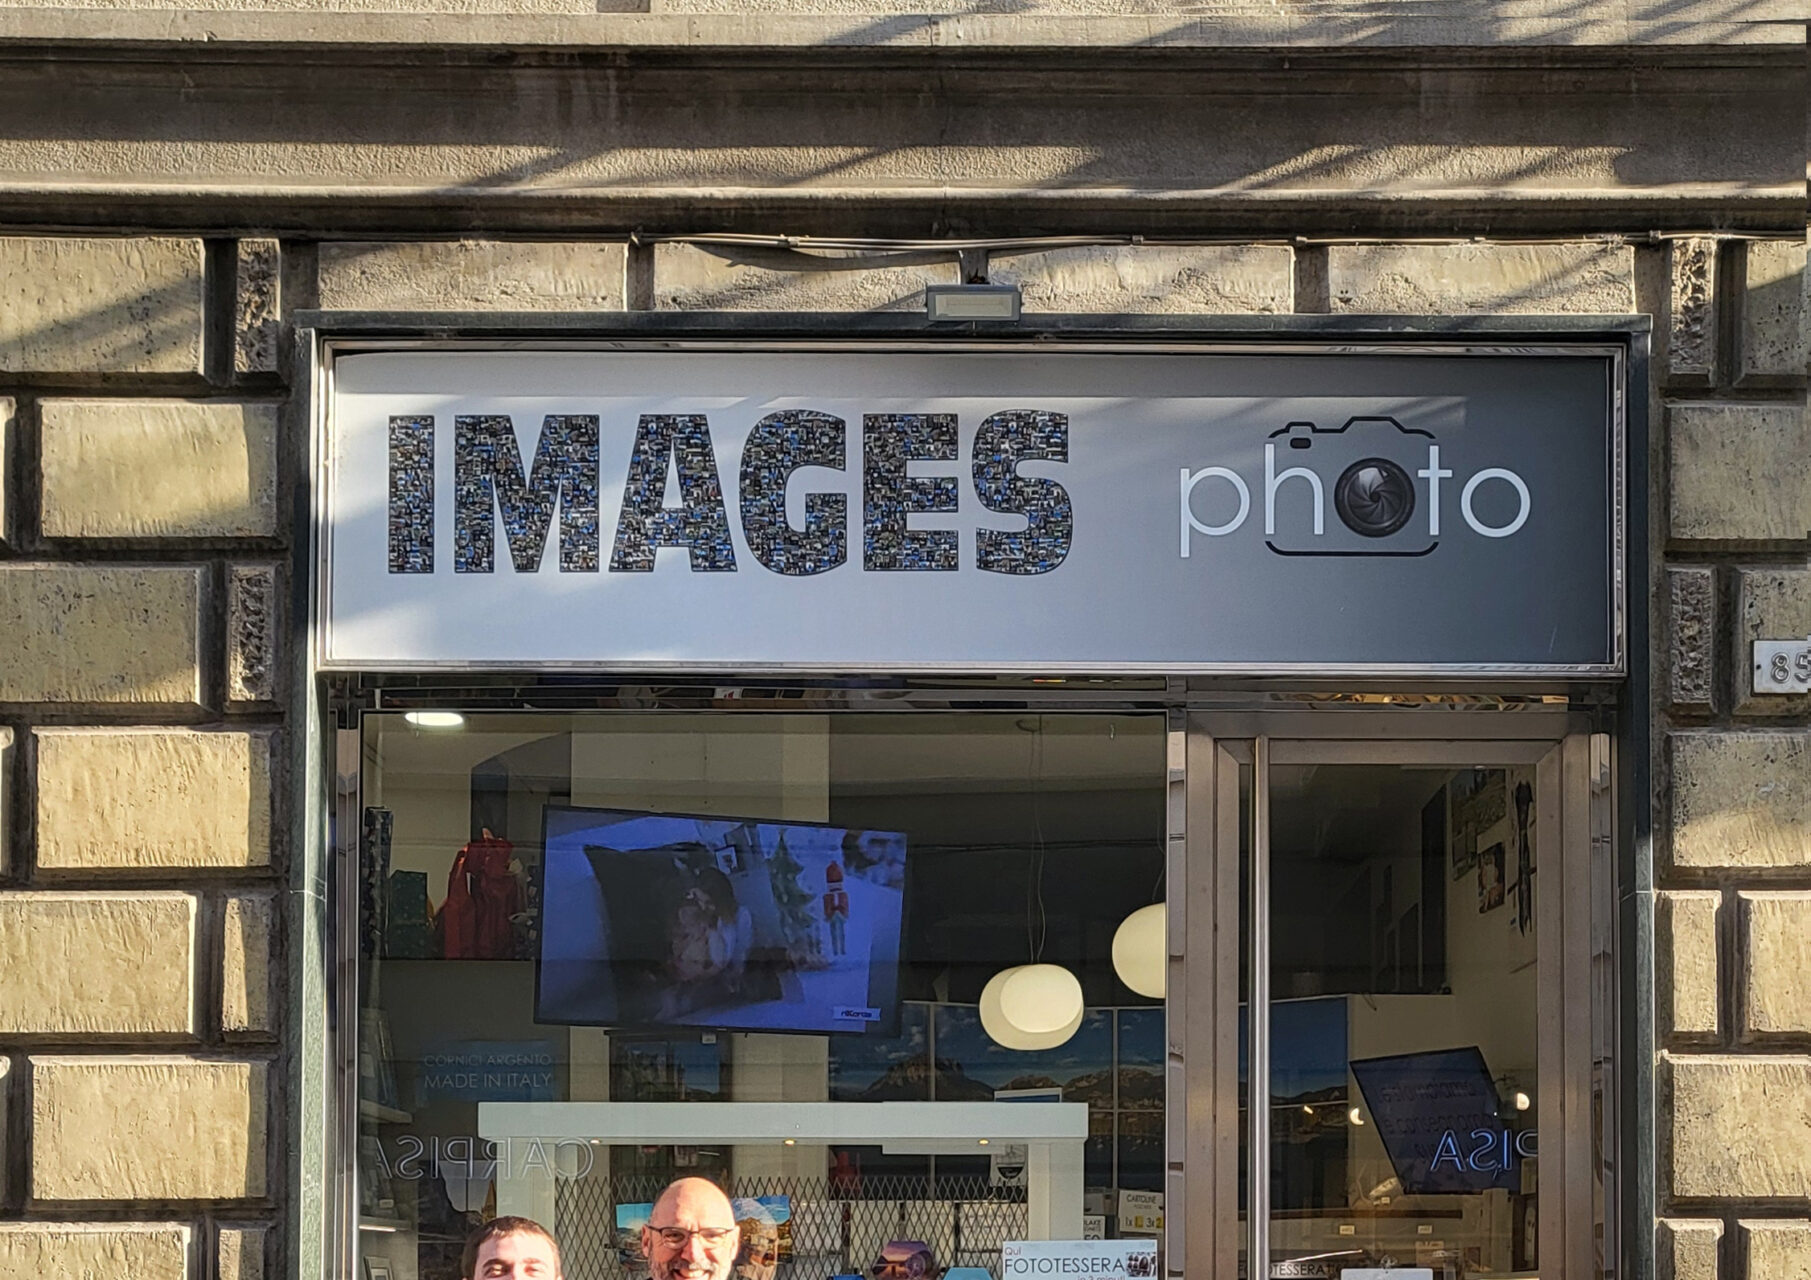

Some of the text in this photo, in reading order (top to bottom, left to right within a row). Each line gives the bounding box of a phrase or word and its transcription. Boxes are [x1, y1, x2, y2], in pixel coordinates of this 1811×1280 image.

[388, 409, 1074, 577] IMAGES
[1180, 443, 1531, 558] photo
[424, 1053, 552, 1067] CORNICI ARGENTO
[424, 1072, 552, 1089] MADE IN ITALY
[1005, 1257, 1126, 1275] FOTOTESSERA
